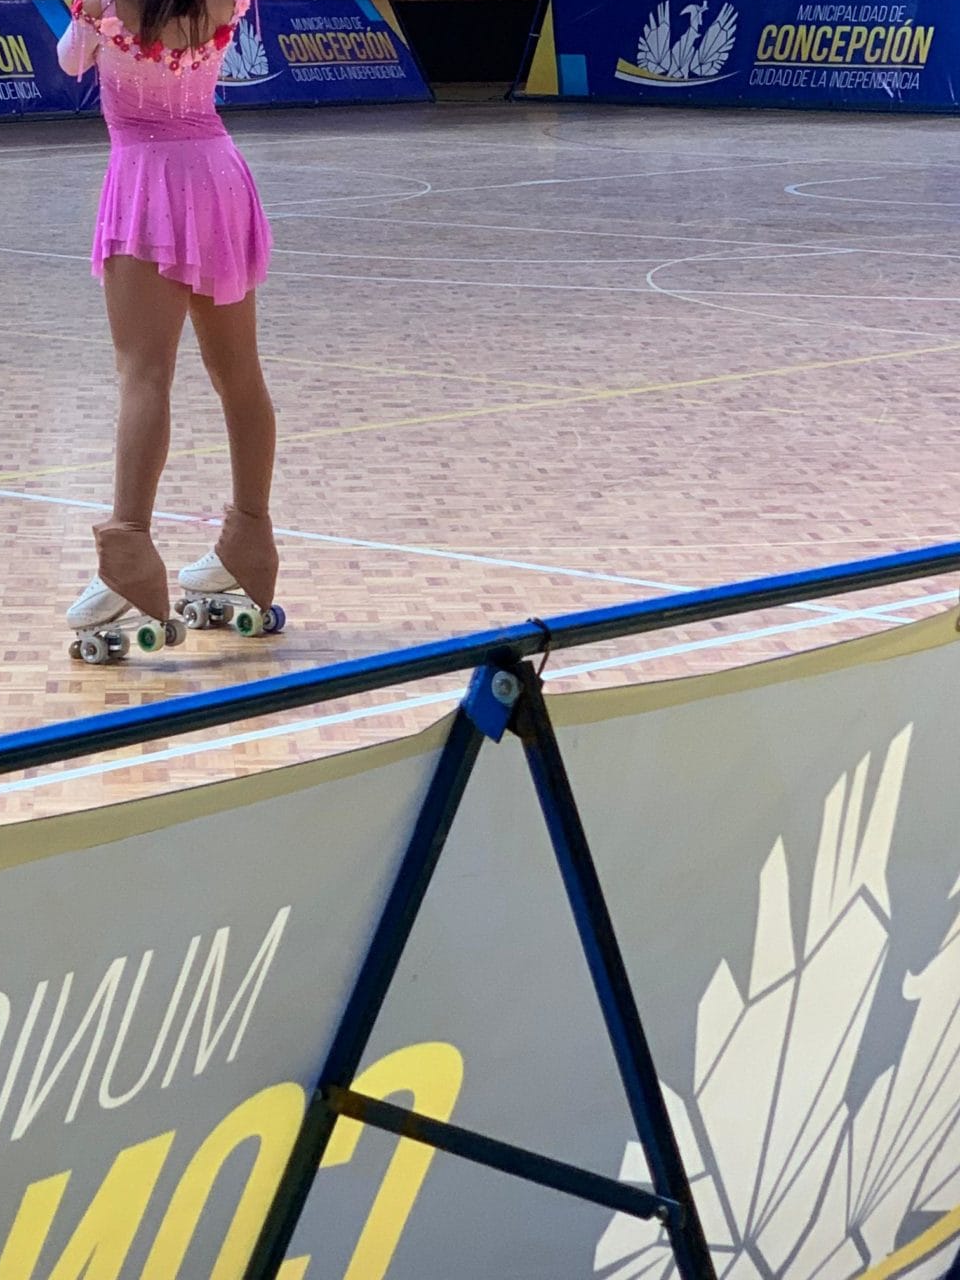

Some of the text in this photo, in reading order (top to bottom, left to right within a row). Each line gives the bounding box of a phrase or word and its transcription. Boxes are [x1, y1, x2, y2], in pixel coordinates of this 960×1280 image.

[796, 4, 907, 23] MUNICIPALIDAD DE
[277, 26, 398, 62] CONCEPCIÓN
[756, 18, 935, 64] CONCEPCIÓN
[749, 68, 920, 90] CIUDAD DE LA INDEPENDENCIA
